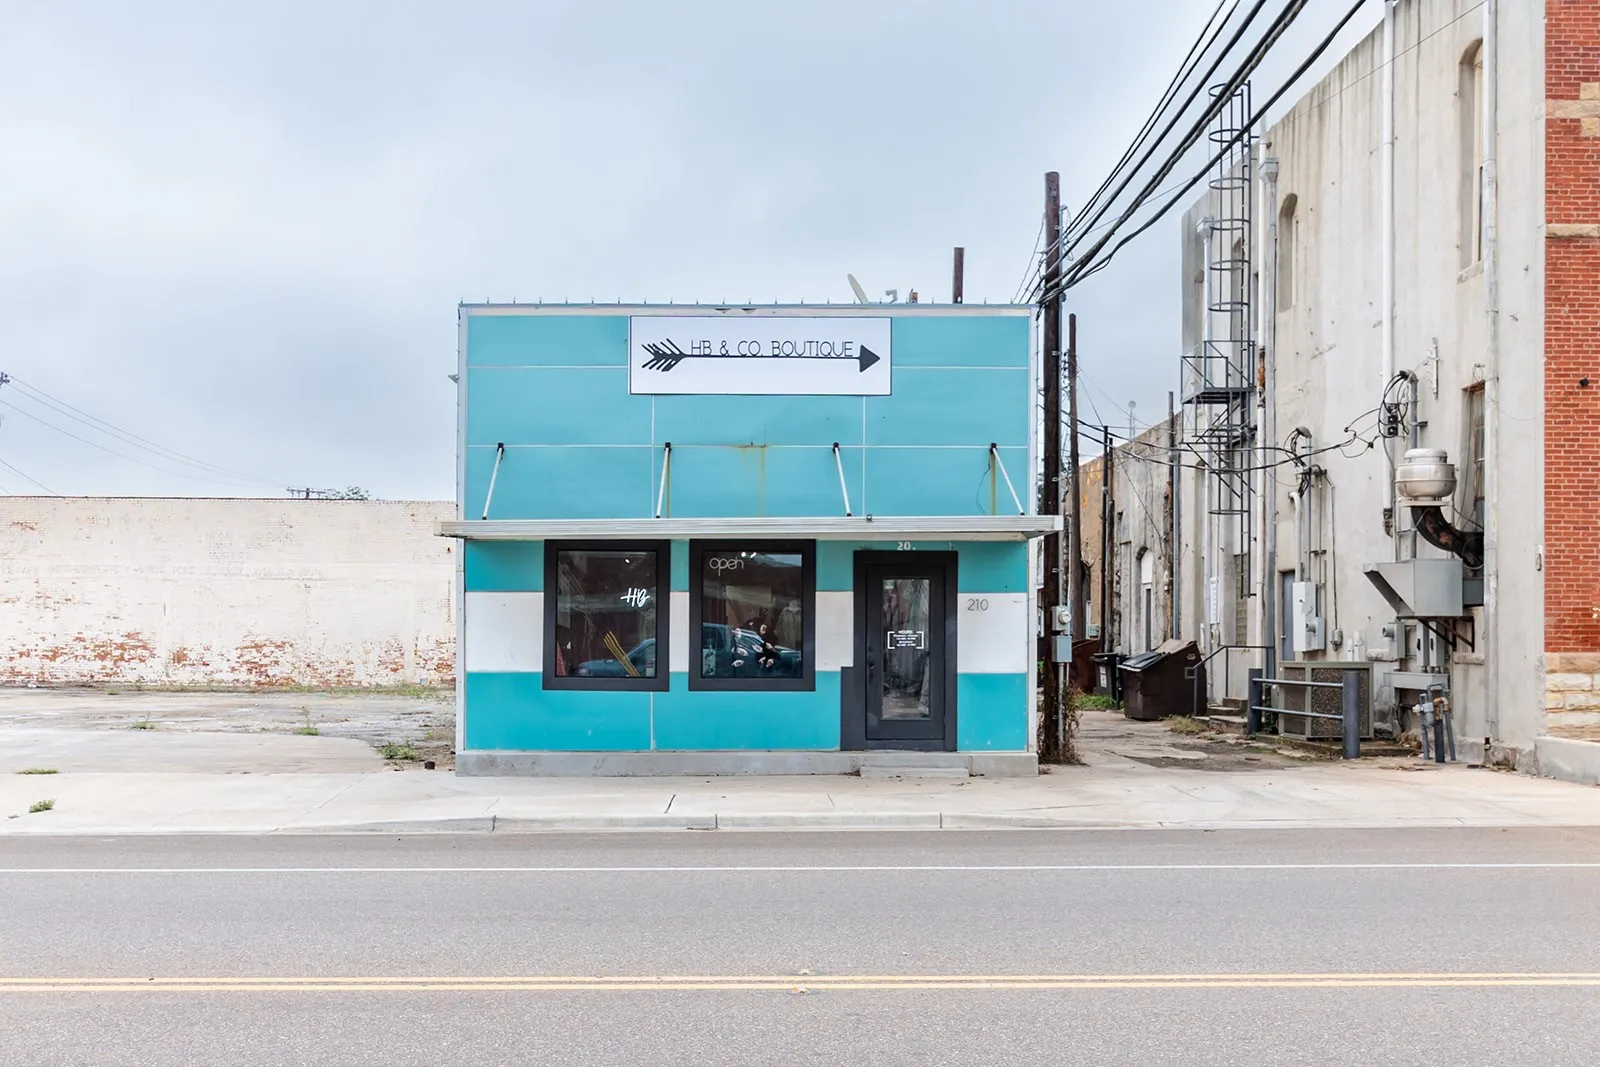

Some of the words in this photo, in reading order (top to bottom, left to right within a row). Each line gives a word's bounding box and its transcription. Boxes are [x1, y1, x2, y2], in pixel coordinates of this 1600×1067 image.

[690, 340, 712, 356] HB
[719, 340, 730, 356] &
[737, 340, 764, 357] CO.
[771, 340, 854, 358] BOUTIQUE
[709, 557, 744, 576] open
[620, 587, 651, 608] HB
[967, 598, 989, 611] 210
